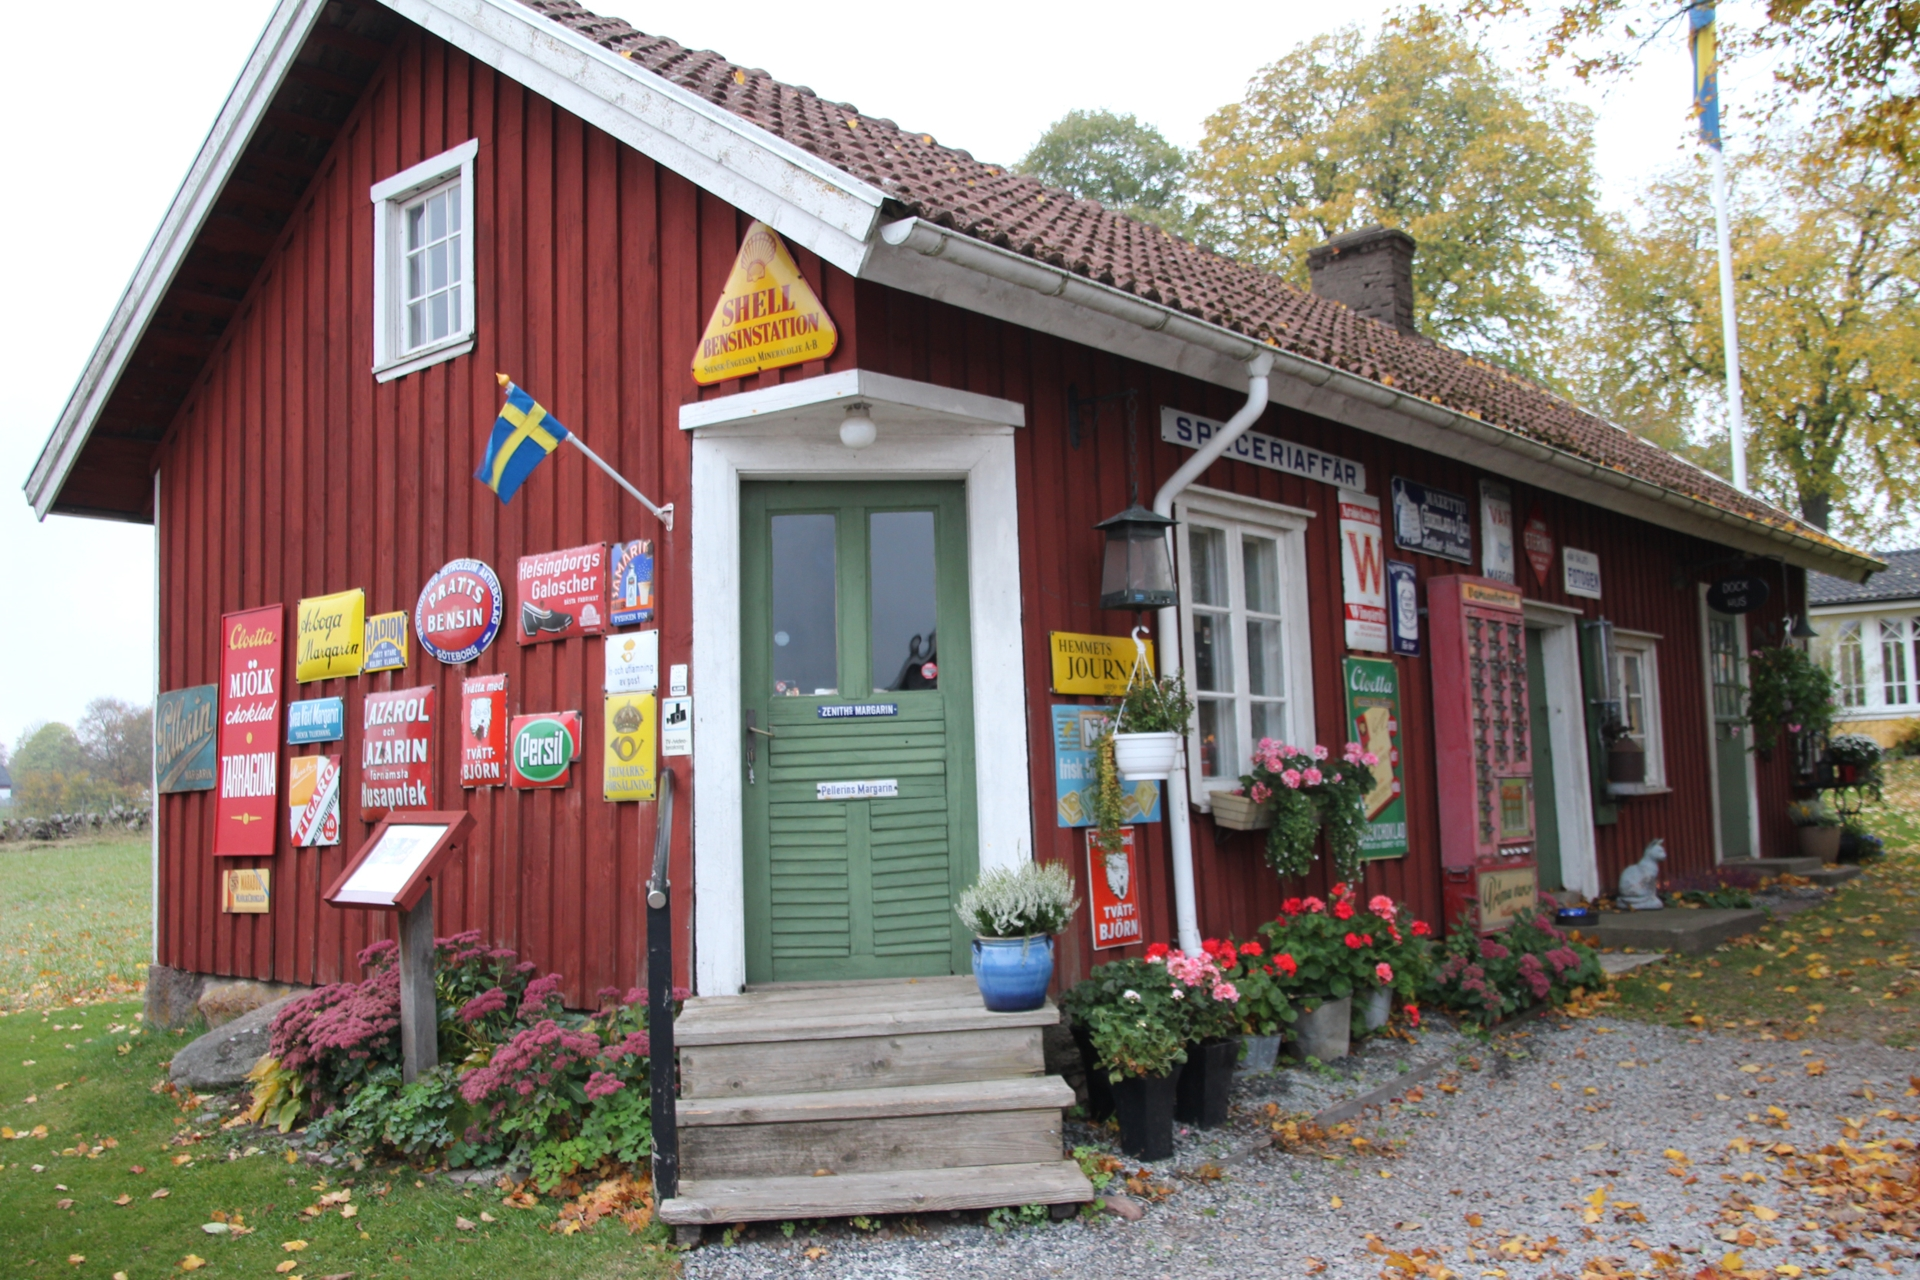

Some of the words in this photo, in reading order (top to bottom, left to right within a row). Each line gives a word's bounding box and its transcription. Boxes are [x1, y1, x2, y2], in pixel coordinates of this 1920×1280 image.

[722, 284, 795, 327] SHELL
[703, 312, 820, 359] BENSINSTATION
[520, 553, 601, 581] Helsingborgs
[612, 539, 651, 599] SAMARIN
[1345, 530, 1384, 597] W
[428, 576, 485, 609] PRATTS
[440, 560, 480, 579] PETROLEUM
[479, 568, 500, 626] AKTIEBOLAG
[531, 574, 598, 601] Galoscher
[1722, 580, 1749, 594] DOCK
[297, 609, 343, 638] Arboga
[427, 607, 483, 634] BENSIN
[614, 612, 637, 623] FYSIKEN
[229, 623, 277, 650] Cloetta
[366, 615, 405, 653] RADION
[1058, 638, 1113, 656] HEMMETS
[297, 642, 359, 669] Margarin
[436, 645, 479, 661] GÖTEBORG
[229, 659, 275, 699] MJÖLK
[627, 676, 641, 687] post
[1066, 655, 1146, 681] JOURNA
[1350, 665, 1395, 694] Cloetta
[463, 682, 487, 695] Tvätta
[488, 680, 504, 691] med
[225, 700, 277, 726] choklad
[313, 702, 339, 729] Margarin
[364, 698, 430, 730] LAZAROL
[854, 704, 894, 715] MARGARIN
[383, 727, 395, 736] och
[362, 738, 428, 769] LAZARIN
[466, 744, 496, 761] TVÄTT-
[519, 731, 564, 768] Persil
[221, 752, 276, 799] TARRAGONA
[370, 769, 409, 780] förnämsta
[463, 760, 500, 780] BJÖRN
[609, 765, 648, 778] FRIMÄRKS-
[1059, 757, 1084, 779] frisk
[361, 779, 427, 812] Husapotek
[606, 779, 652, 792] FÖRSÄLJNING
[821, 784, 856, 797] Pellerins
[297, 764, 336, 841] FIGARO
[326, 819, 335, 830] 10
[1103, 902, 1135, 919] TVÄTT-
[1099, 918, 1139, 941] BJÖRN
